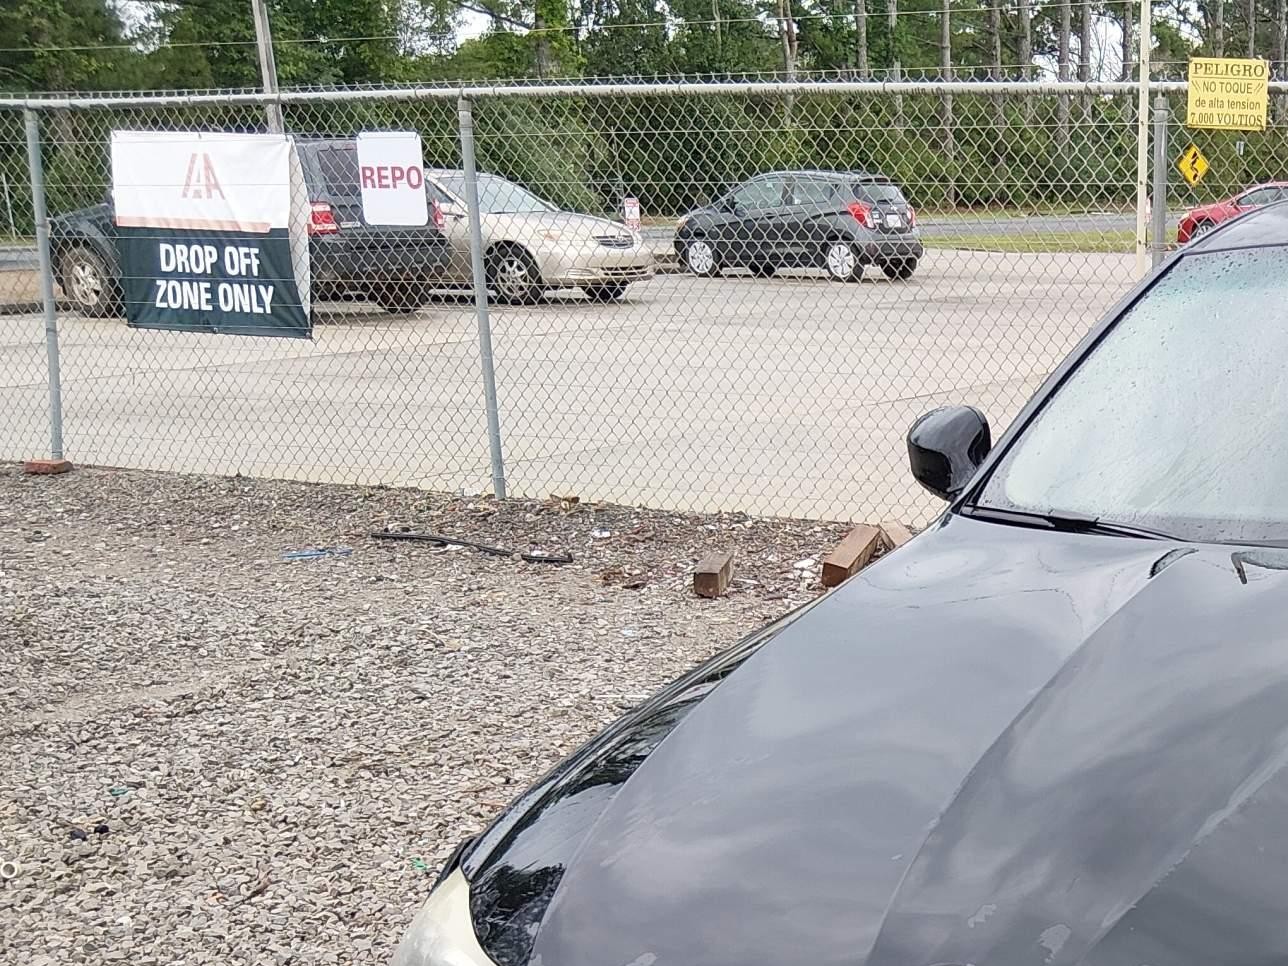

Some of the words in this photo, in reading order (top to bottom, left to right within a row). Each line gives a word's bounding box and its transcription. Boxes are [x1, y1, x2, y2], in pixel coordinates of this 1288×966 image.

[1192, 62, 1265, 77] PELIGRO
[1202, 81, 1217, 93] NO
[1219, 81, 1253, 95] TOQUE
[1194, 97, 1206, 108] de
[1208, 97, 1225, 109] alta
[1227, 98, 1261, 111] tension
[1216, 113, 1263, 128] VOLTIOS
[361, 165, 424, 190] REPO
[159, 242, 218, 274] DROP
[224, 246, 260, 277] OFF
[155, 279, 213, 312] ZONE
[217, 282, 275, 314] ONLY
